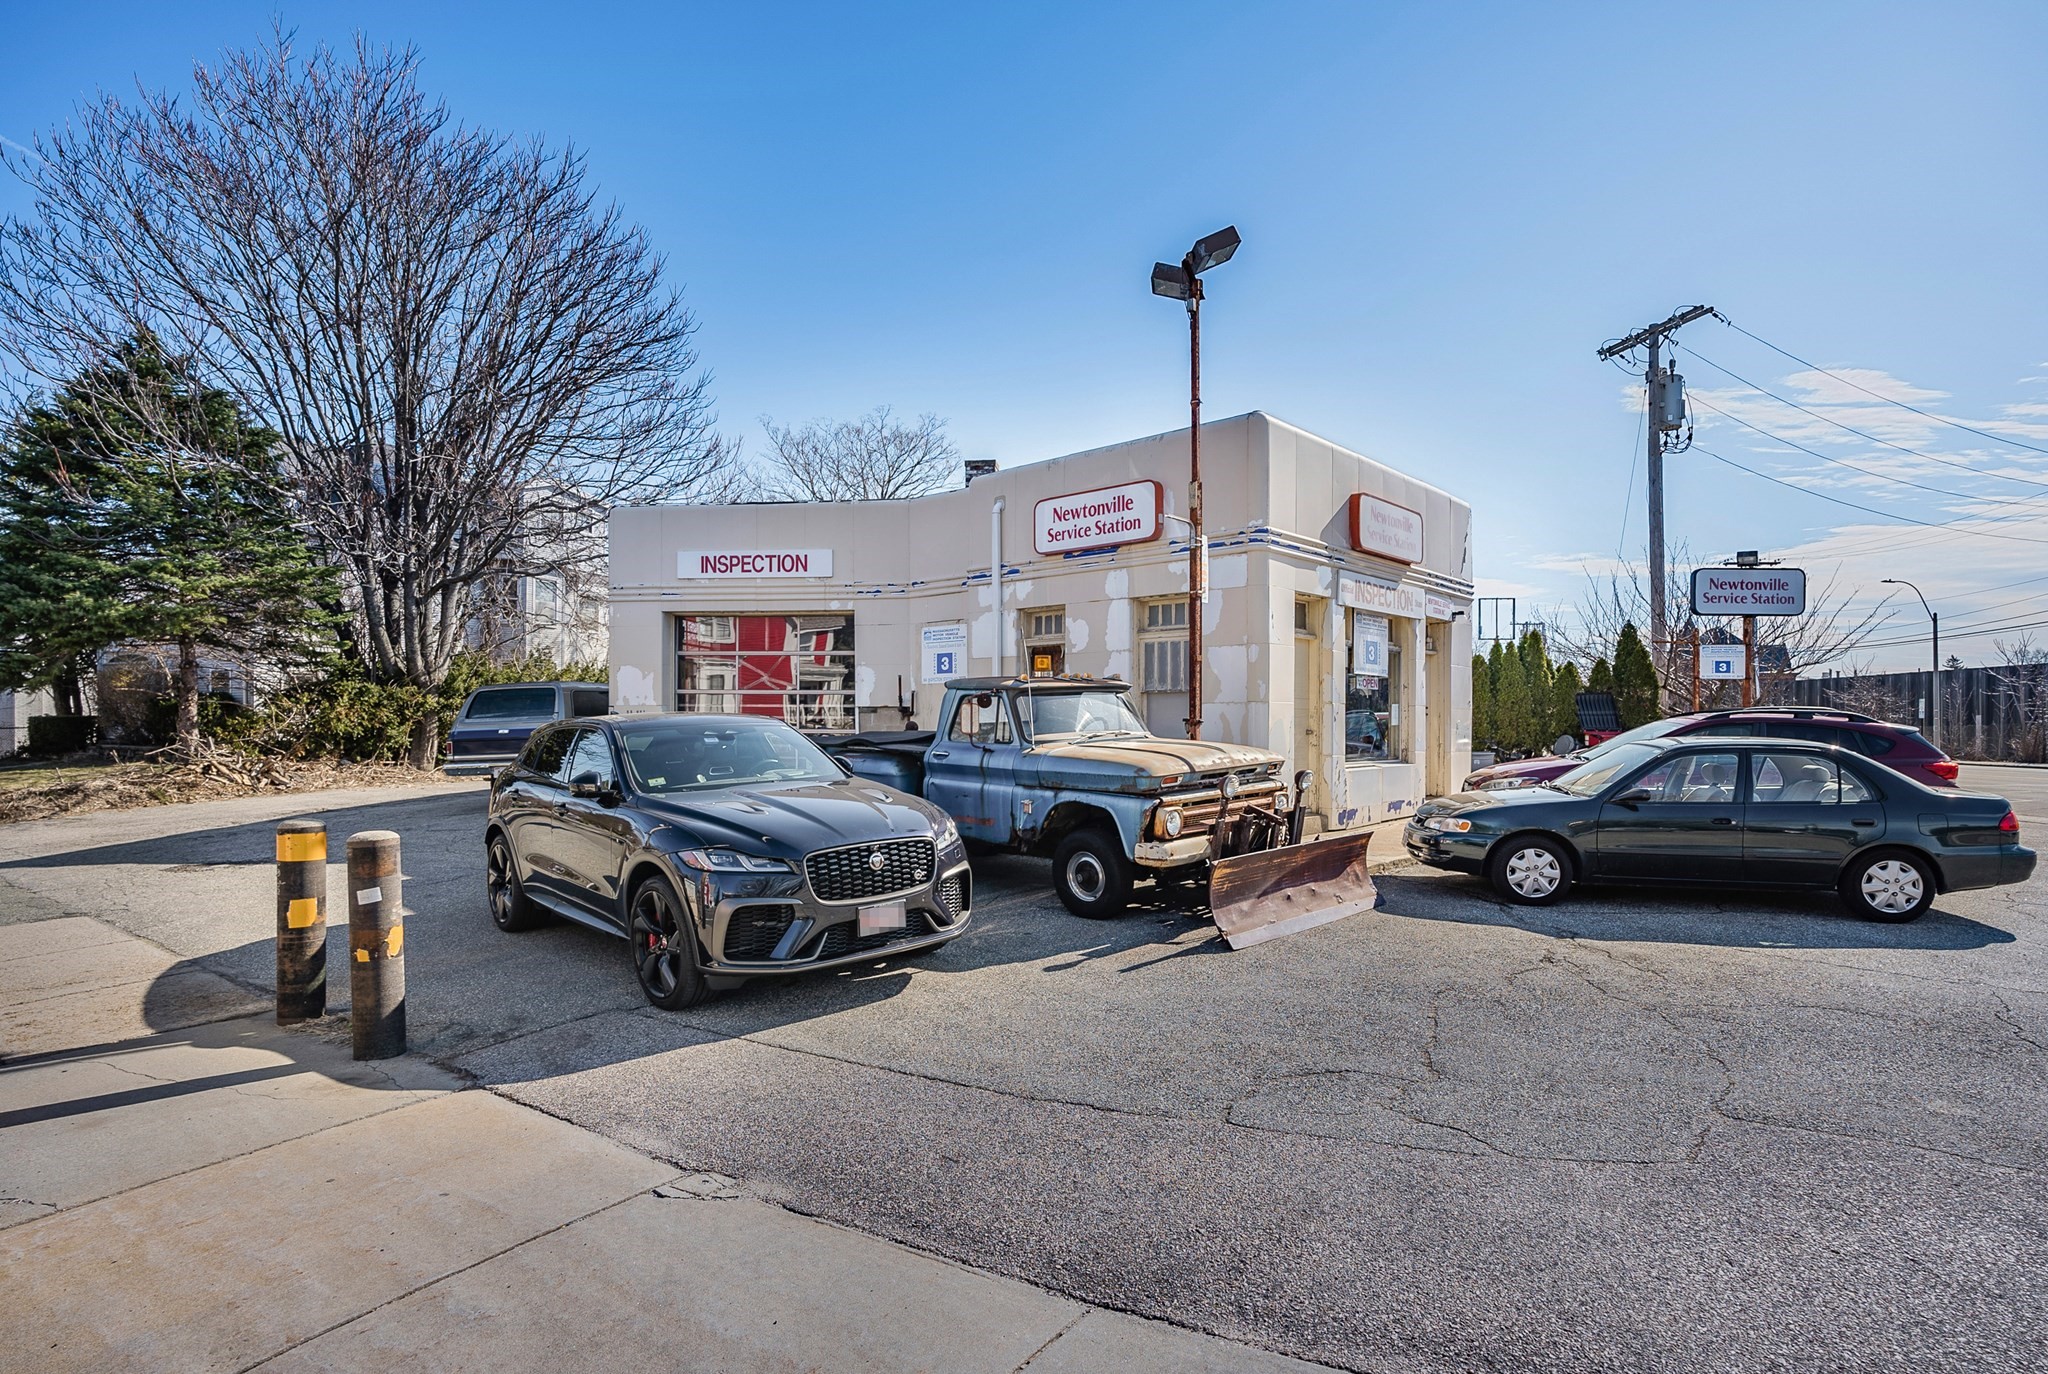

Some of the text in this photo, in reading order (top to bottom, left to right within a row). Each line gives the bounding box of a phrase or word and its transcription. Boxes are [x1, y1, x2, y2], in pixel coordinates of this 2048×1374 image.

[1053, 495, 1134, 523] Newtonville
[1371, 504, 1413, 533] Newtonville
[1047, 516, 1141, 543] Service Station
[1368, 525, 1417, 553] Service Station
[701, 554, 808, 573] INSPECTION
[1709, 577, 1789, 591] Newtonville
[1355, 579, 1414, 612] INSPECTION
[1703, 592, 1795, 605] Service Station
[1368, 645, 1375, 661] 3
[940, 656, 949, 671] 3
[1718, 662, 1727, 672] 3
[1362, 678, 1378, 688] OPEN
